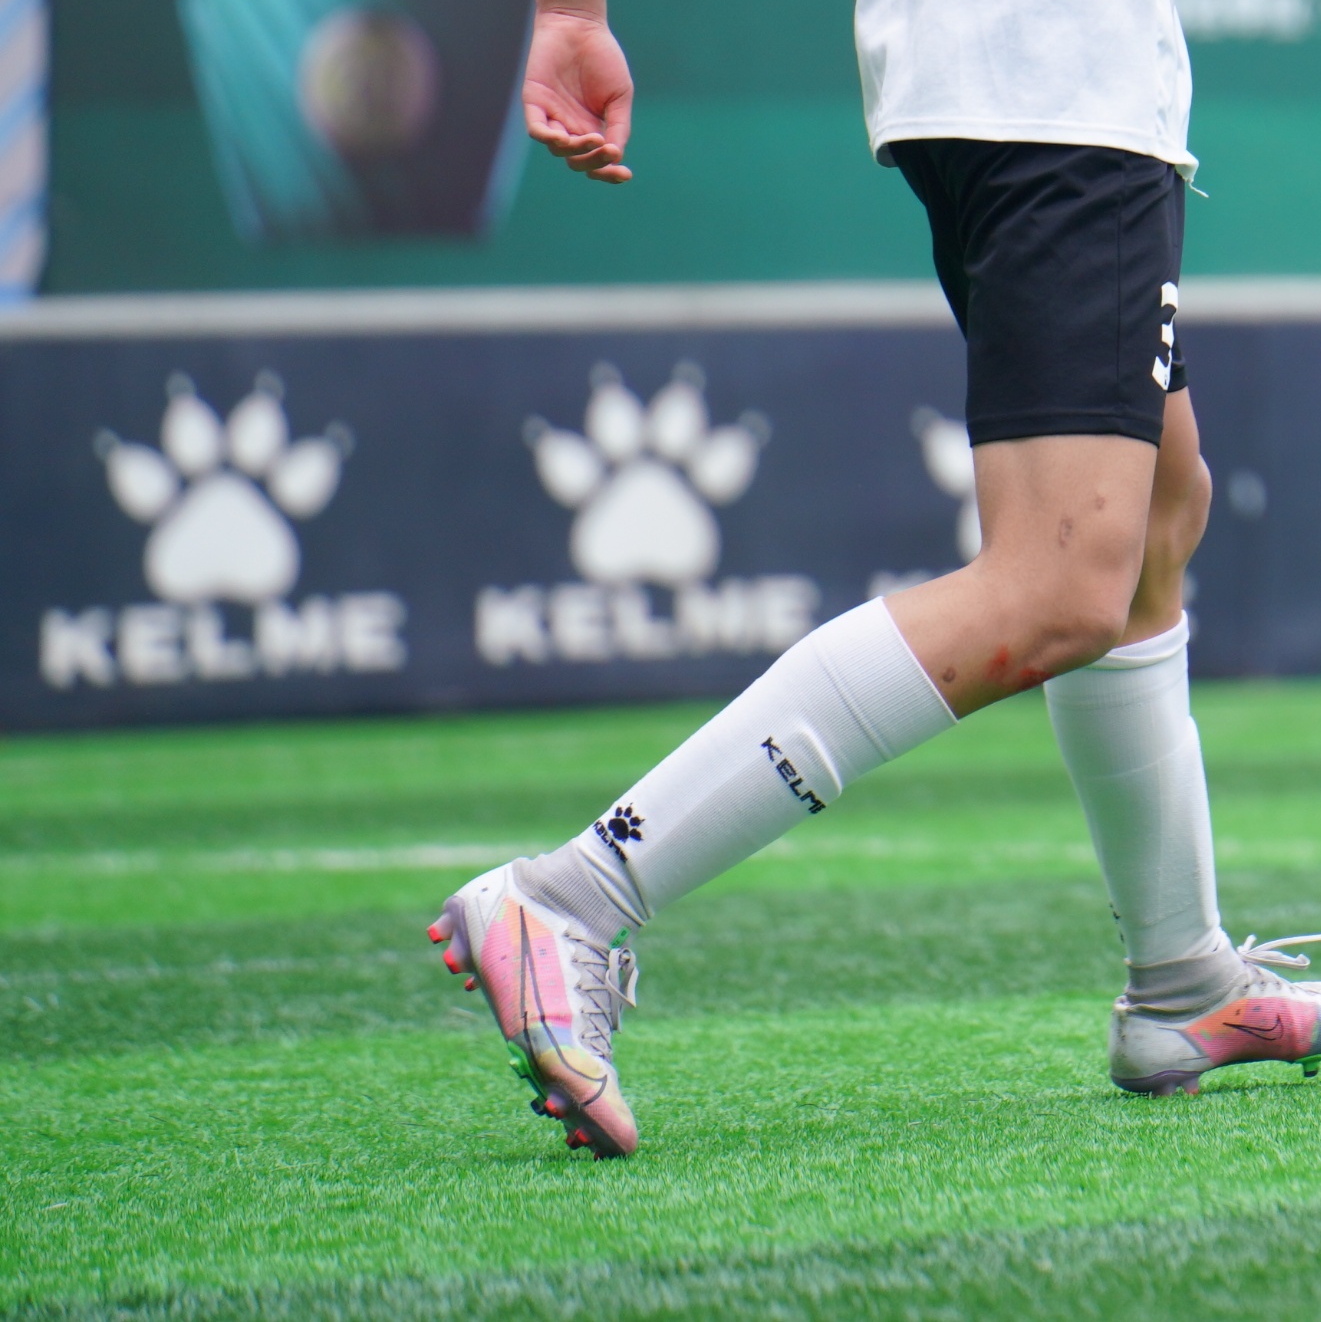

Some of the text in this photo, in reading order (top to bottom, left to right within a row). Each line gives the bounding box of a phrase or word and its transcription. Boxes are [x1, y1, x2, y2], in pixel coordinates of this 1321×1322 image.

[39, 594, 405, 685] KELME
[475, 576, 820, 664] KELME
[761, 736, 827, 815] KELM
